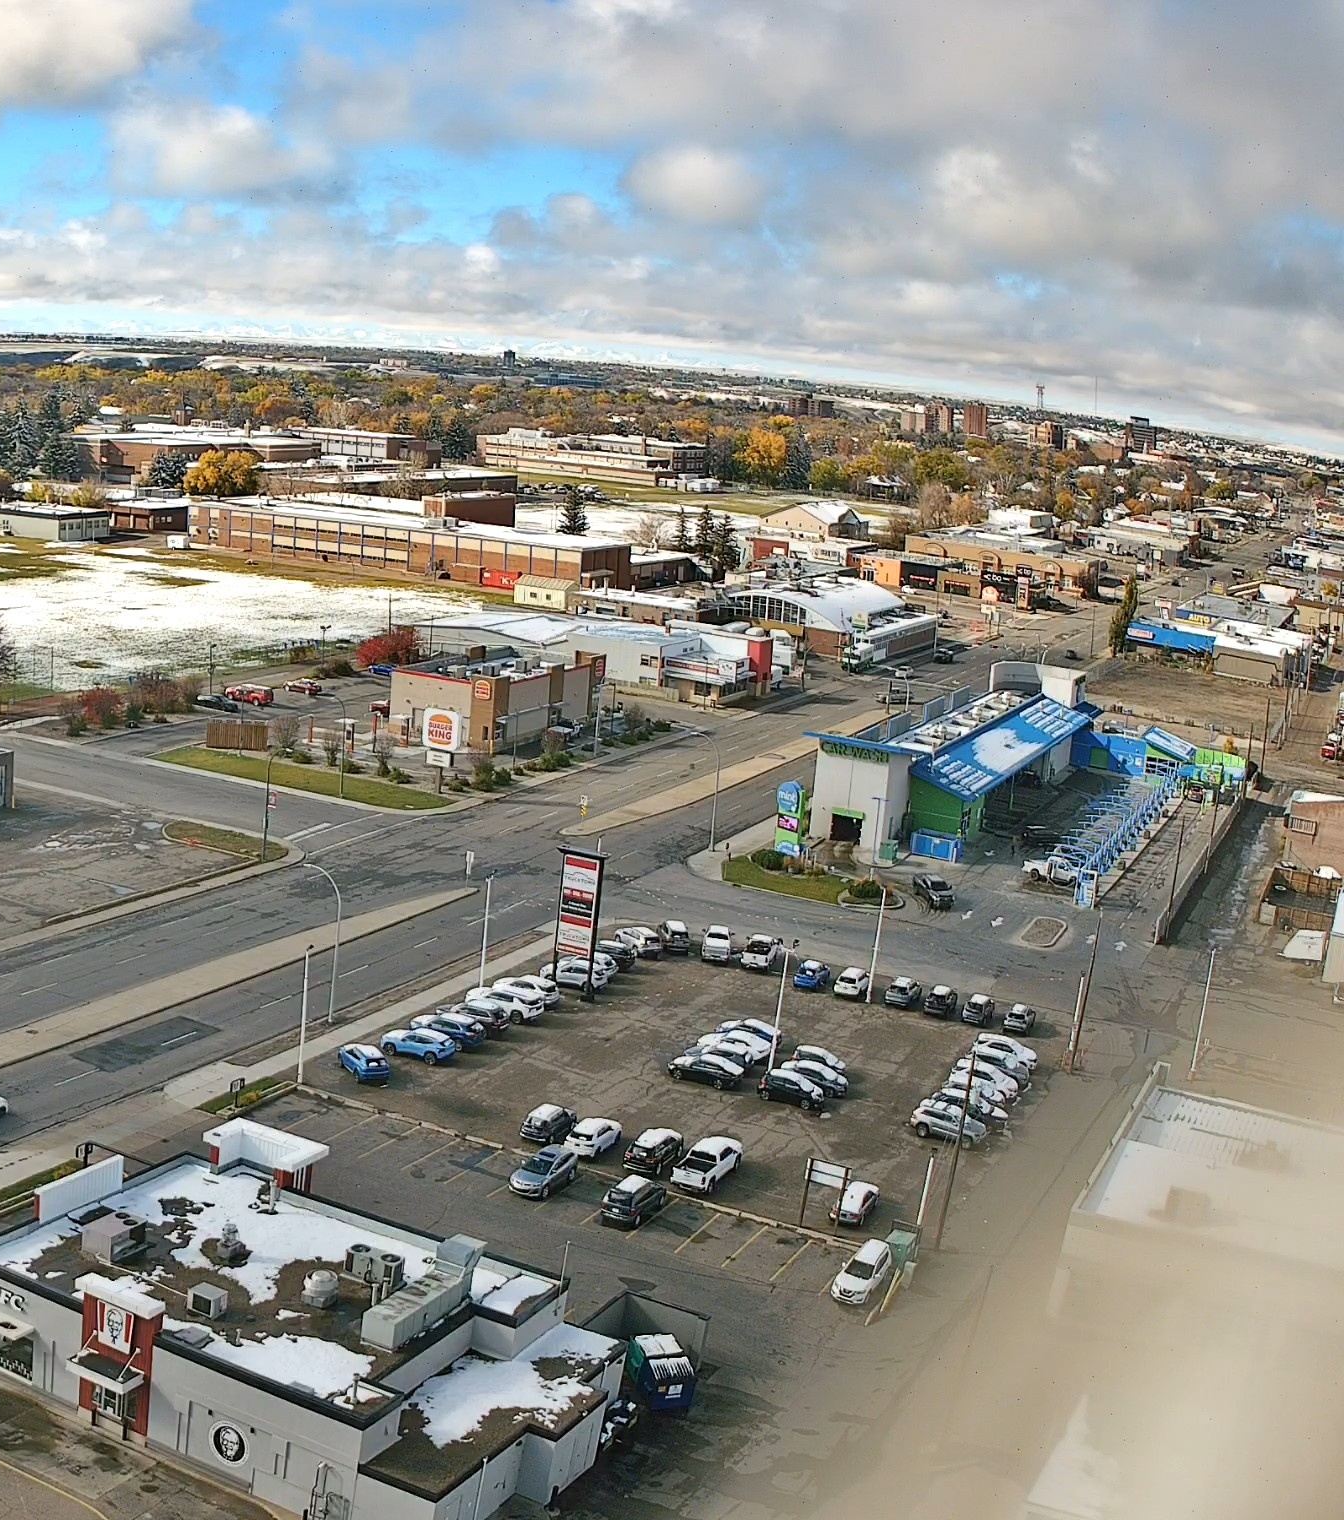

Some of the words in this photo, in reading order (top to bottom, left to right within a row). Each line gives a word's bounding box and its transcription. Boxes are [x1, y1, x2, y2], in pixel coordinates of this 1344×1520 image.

[1189, 613, 1211, 627] AUTO
[428, 721, 453, 733] BURGER
[428, 728, 452, 740] KING
[821, 742, 847, 756] CAR
[849, 746, 890, 764] WASH
[778, 790, 796, 802] mint
